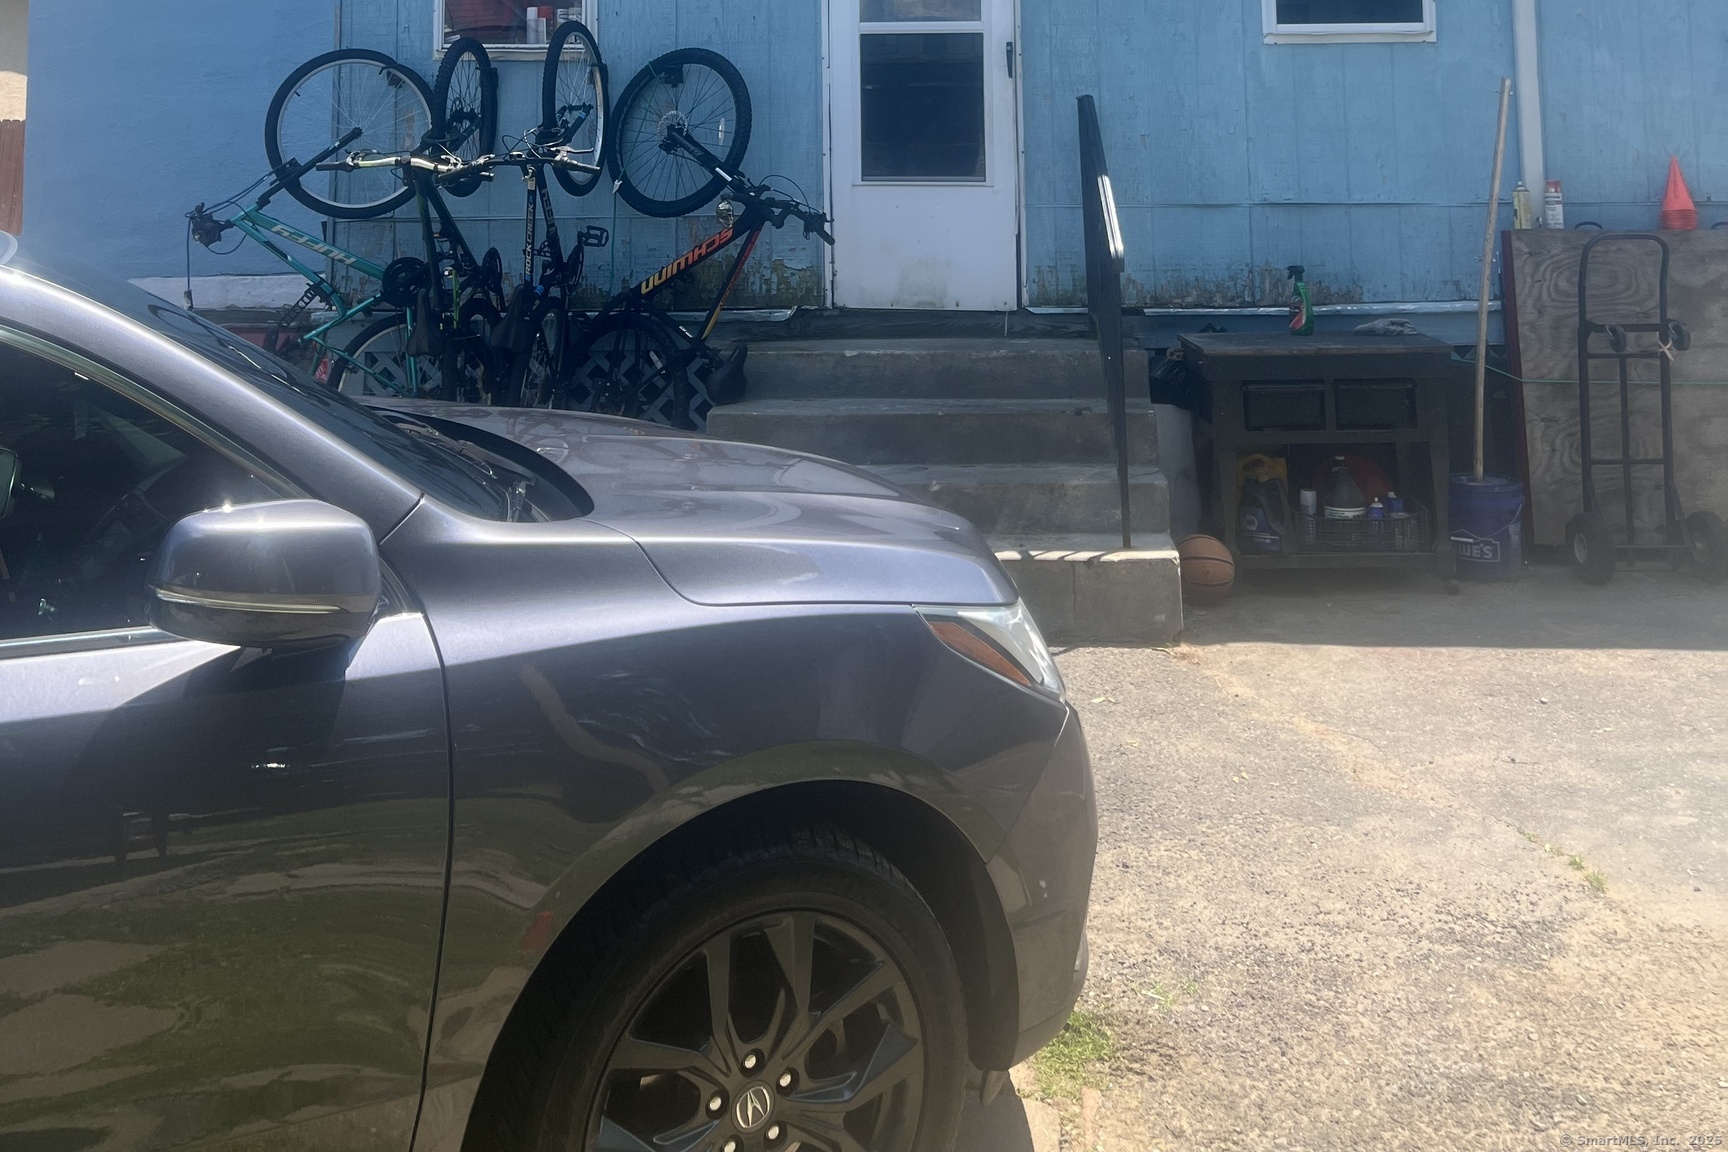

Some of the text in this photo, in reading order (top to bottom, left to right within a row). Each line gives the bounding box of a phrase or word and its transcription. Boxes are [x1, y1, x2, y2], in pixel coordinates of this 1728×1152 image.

[526, 203, 534, 243] CREEK
[271, 224, 356, 264] HUFFY
[640, 228, 733, 295] SCHWINN
[1458, 543, 1493, 559] WE'S
